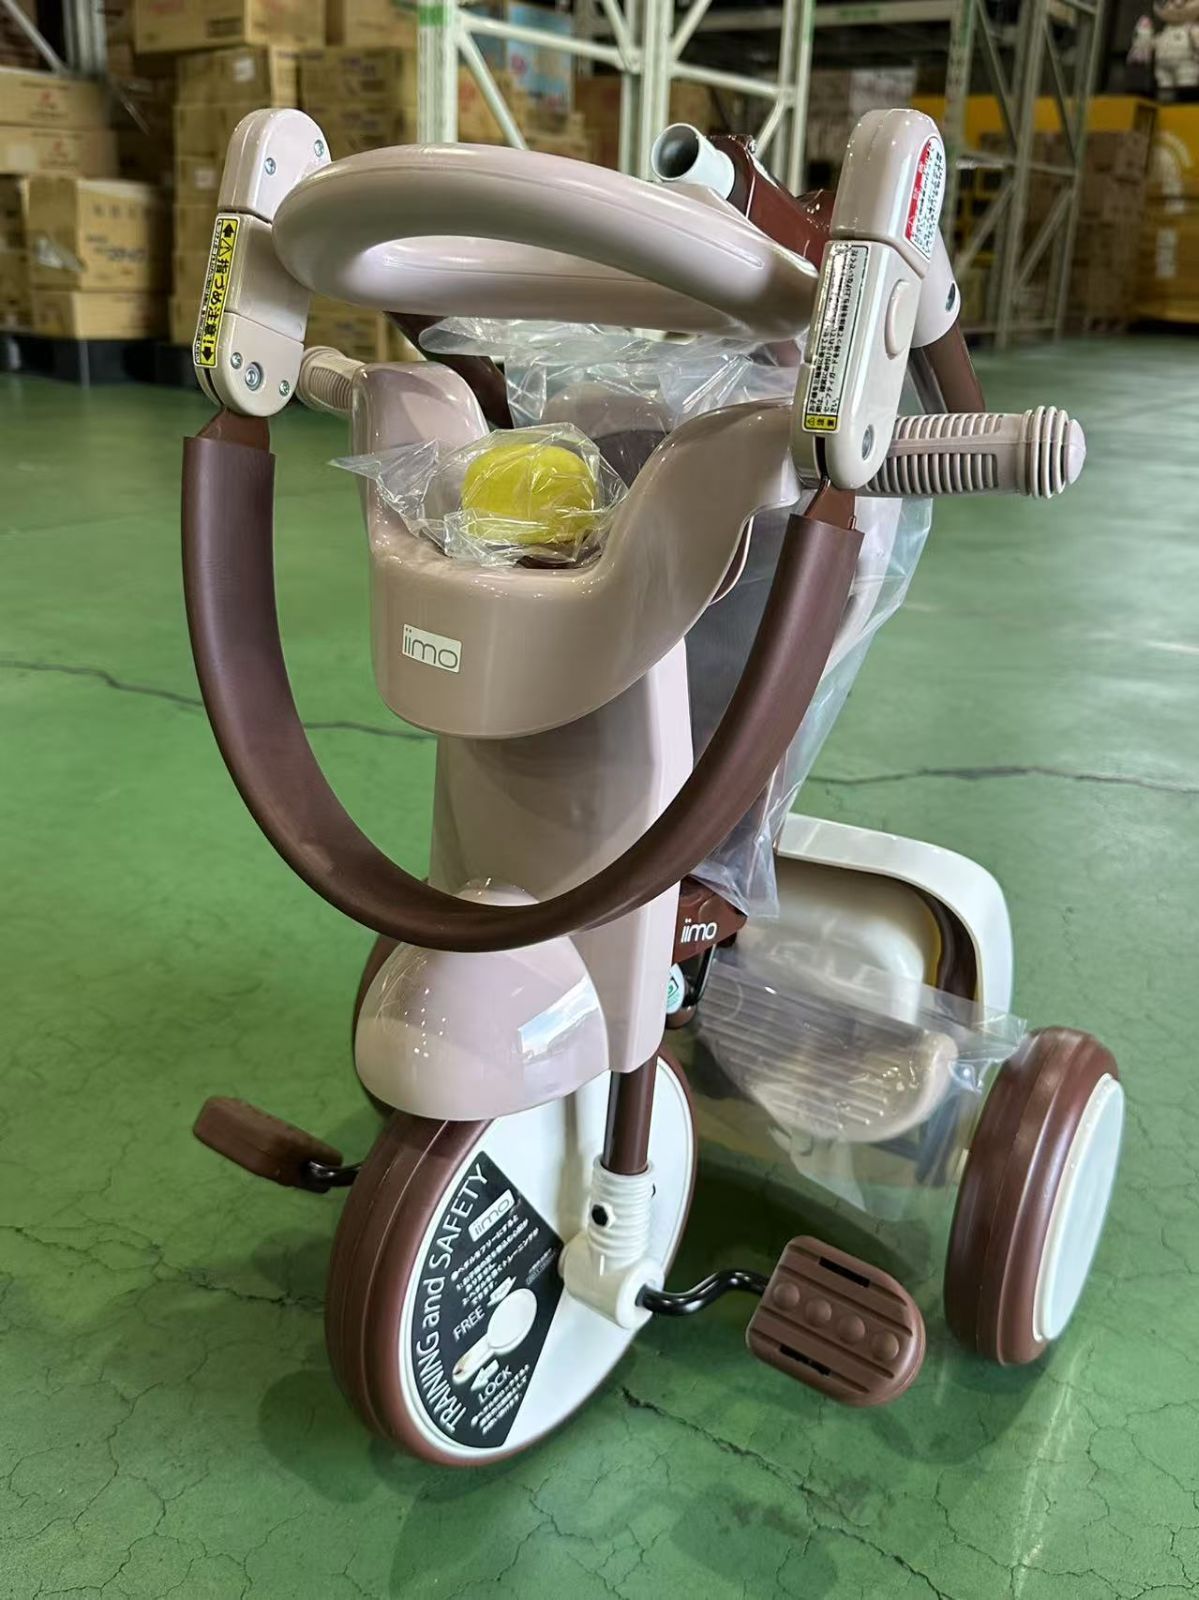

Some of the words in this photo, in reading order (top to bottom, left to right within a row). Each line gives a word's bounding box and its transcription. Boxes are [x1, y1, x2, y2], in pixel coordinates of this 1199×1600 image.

[405, 627, 458, 668] iimo
[681, 918, 717, 943] iimo
[428, 1163, 488, 1269] SAFETY
[474, 1198, 511, 1236] iimo
[421, 1276, 446, 1330] and
[452, 1305, 485, 1342] FREE
[416, 1331, 467, 1433] TRAINING
[477, 1362, 513, 1404] LOCK
